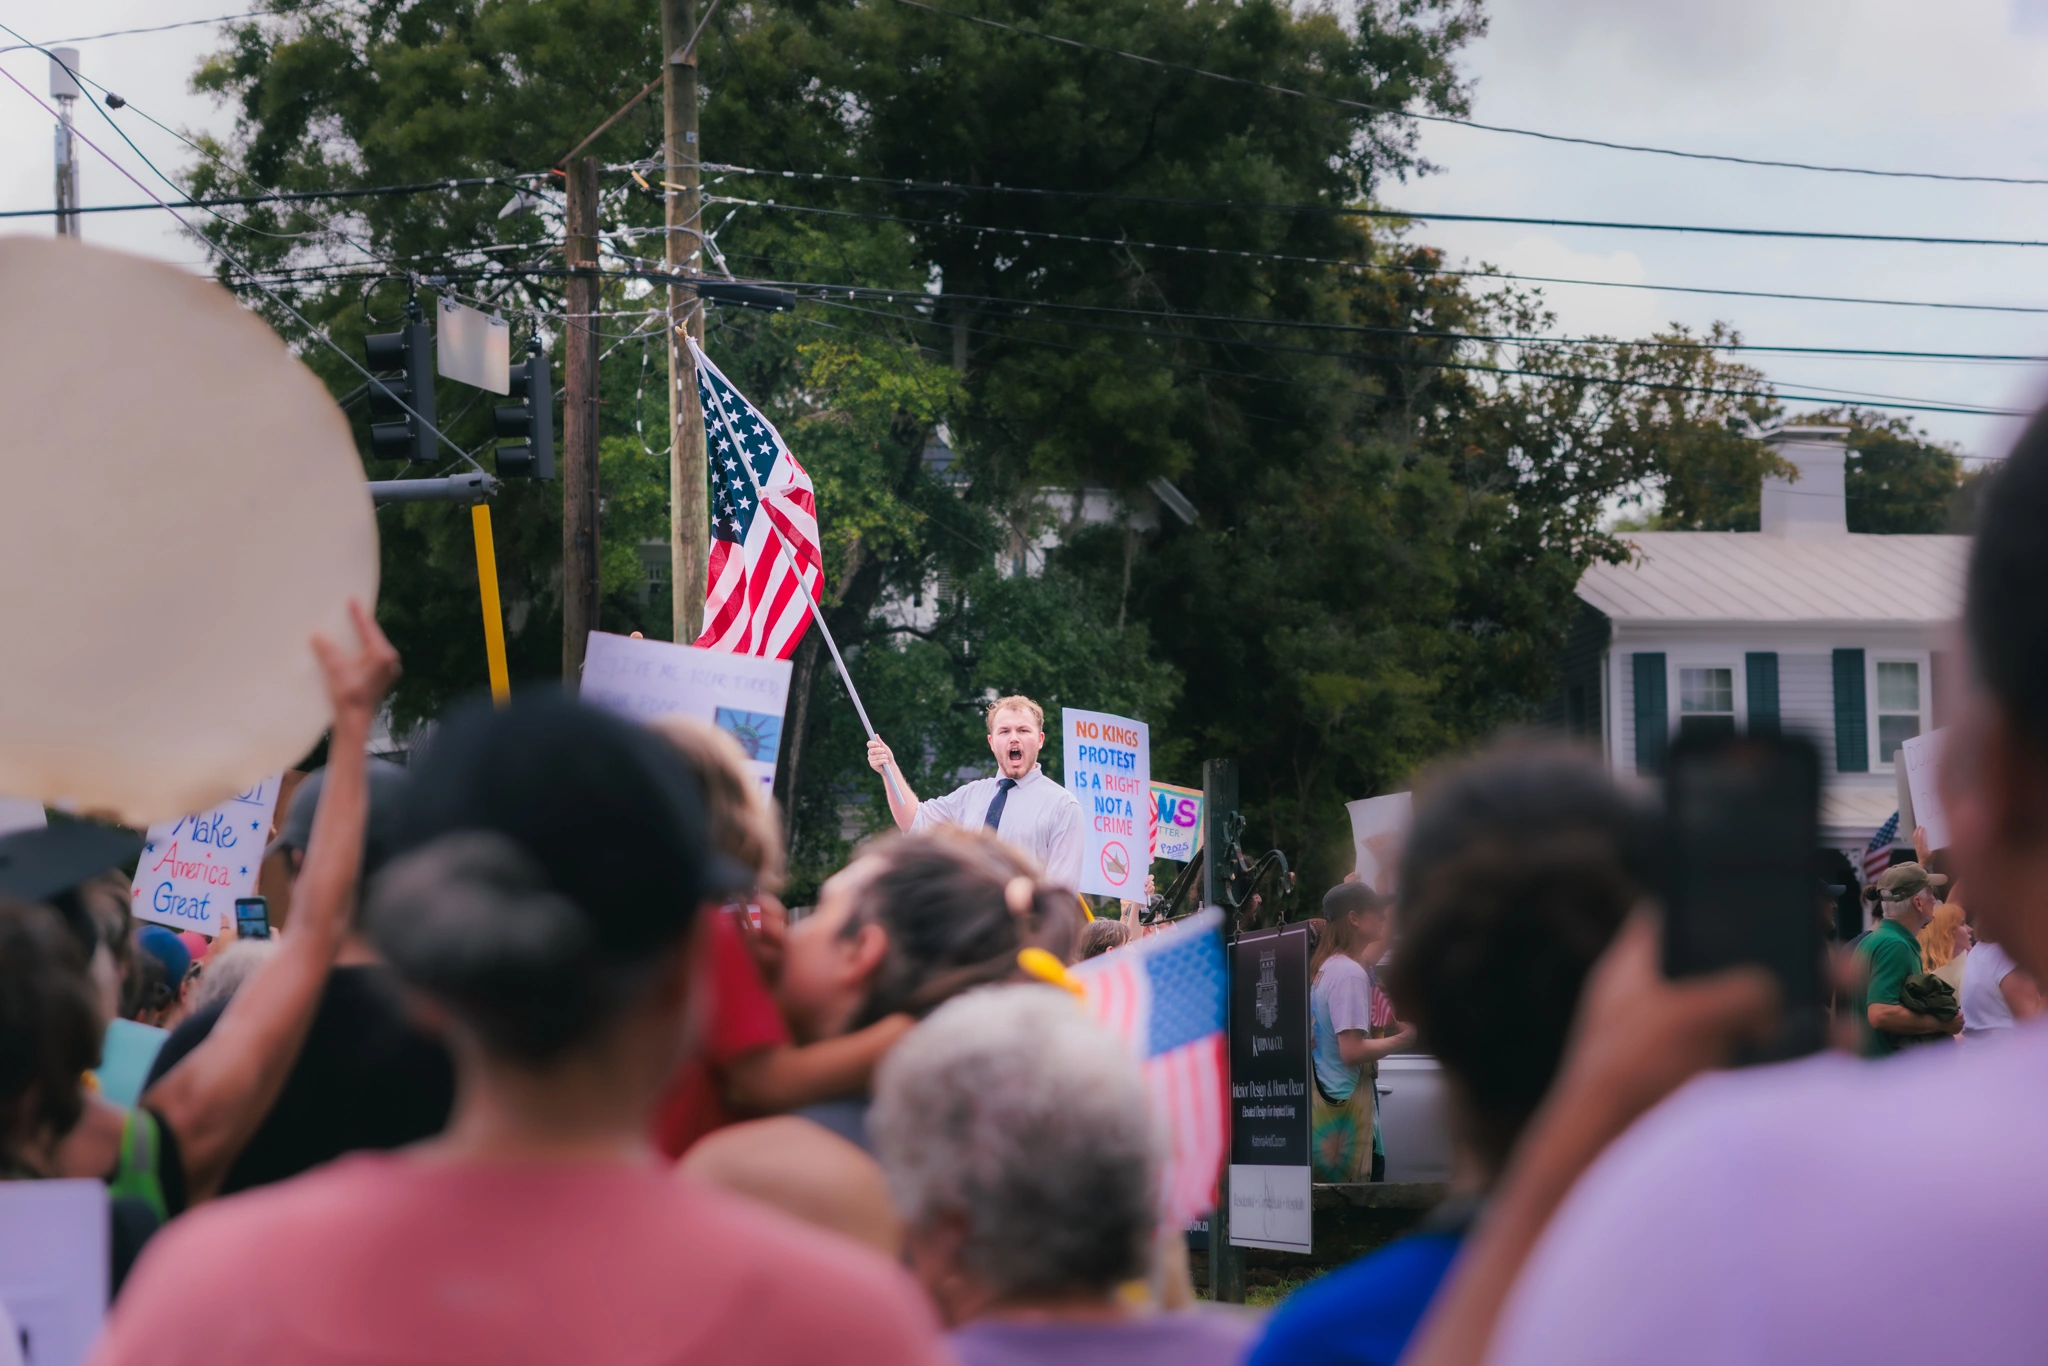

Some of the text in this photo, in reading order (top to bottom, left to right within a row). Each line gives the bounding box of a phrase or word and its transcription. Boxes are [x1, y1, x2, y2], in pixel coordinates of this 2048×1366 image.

[1076, 720, 1138, 748] NO KINGS
[1078, 745, 1136, 769] PROTEST
[1075, 771, 1140, 795] IS A RIGHT
[1094, 796, 1133, 817] NOT A
[1157, 793, 1197, 827] NS
[1094, 815, 1133, 836] CRIME
[152, 841, 231, 886] America
[153, 881, 211, 921] Great
[1232, 1078, 1305, 1101] Interior Design & Home Decor
[1256, 1105, 1266, 1119] Design
